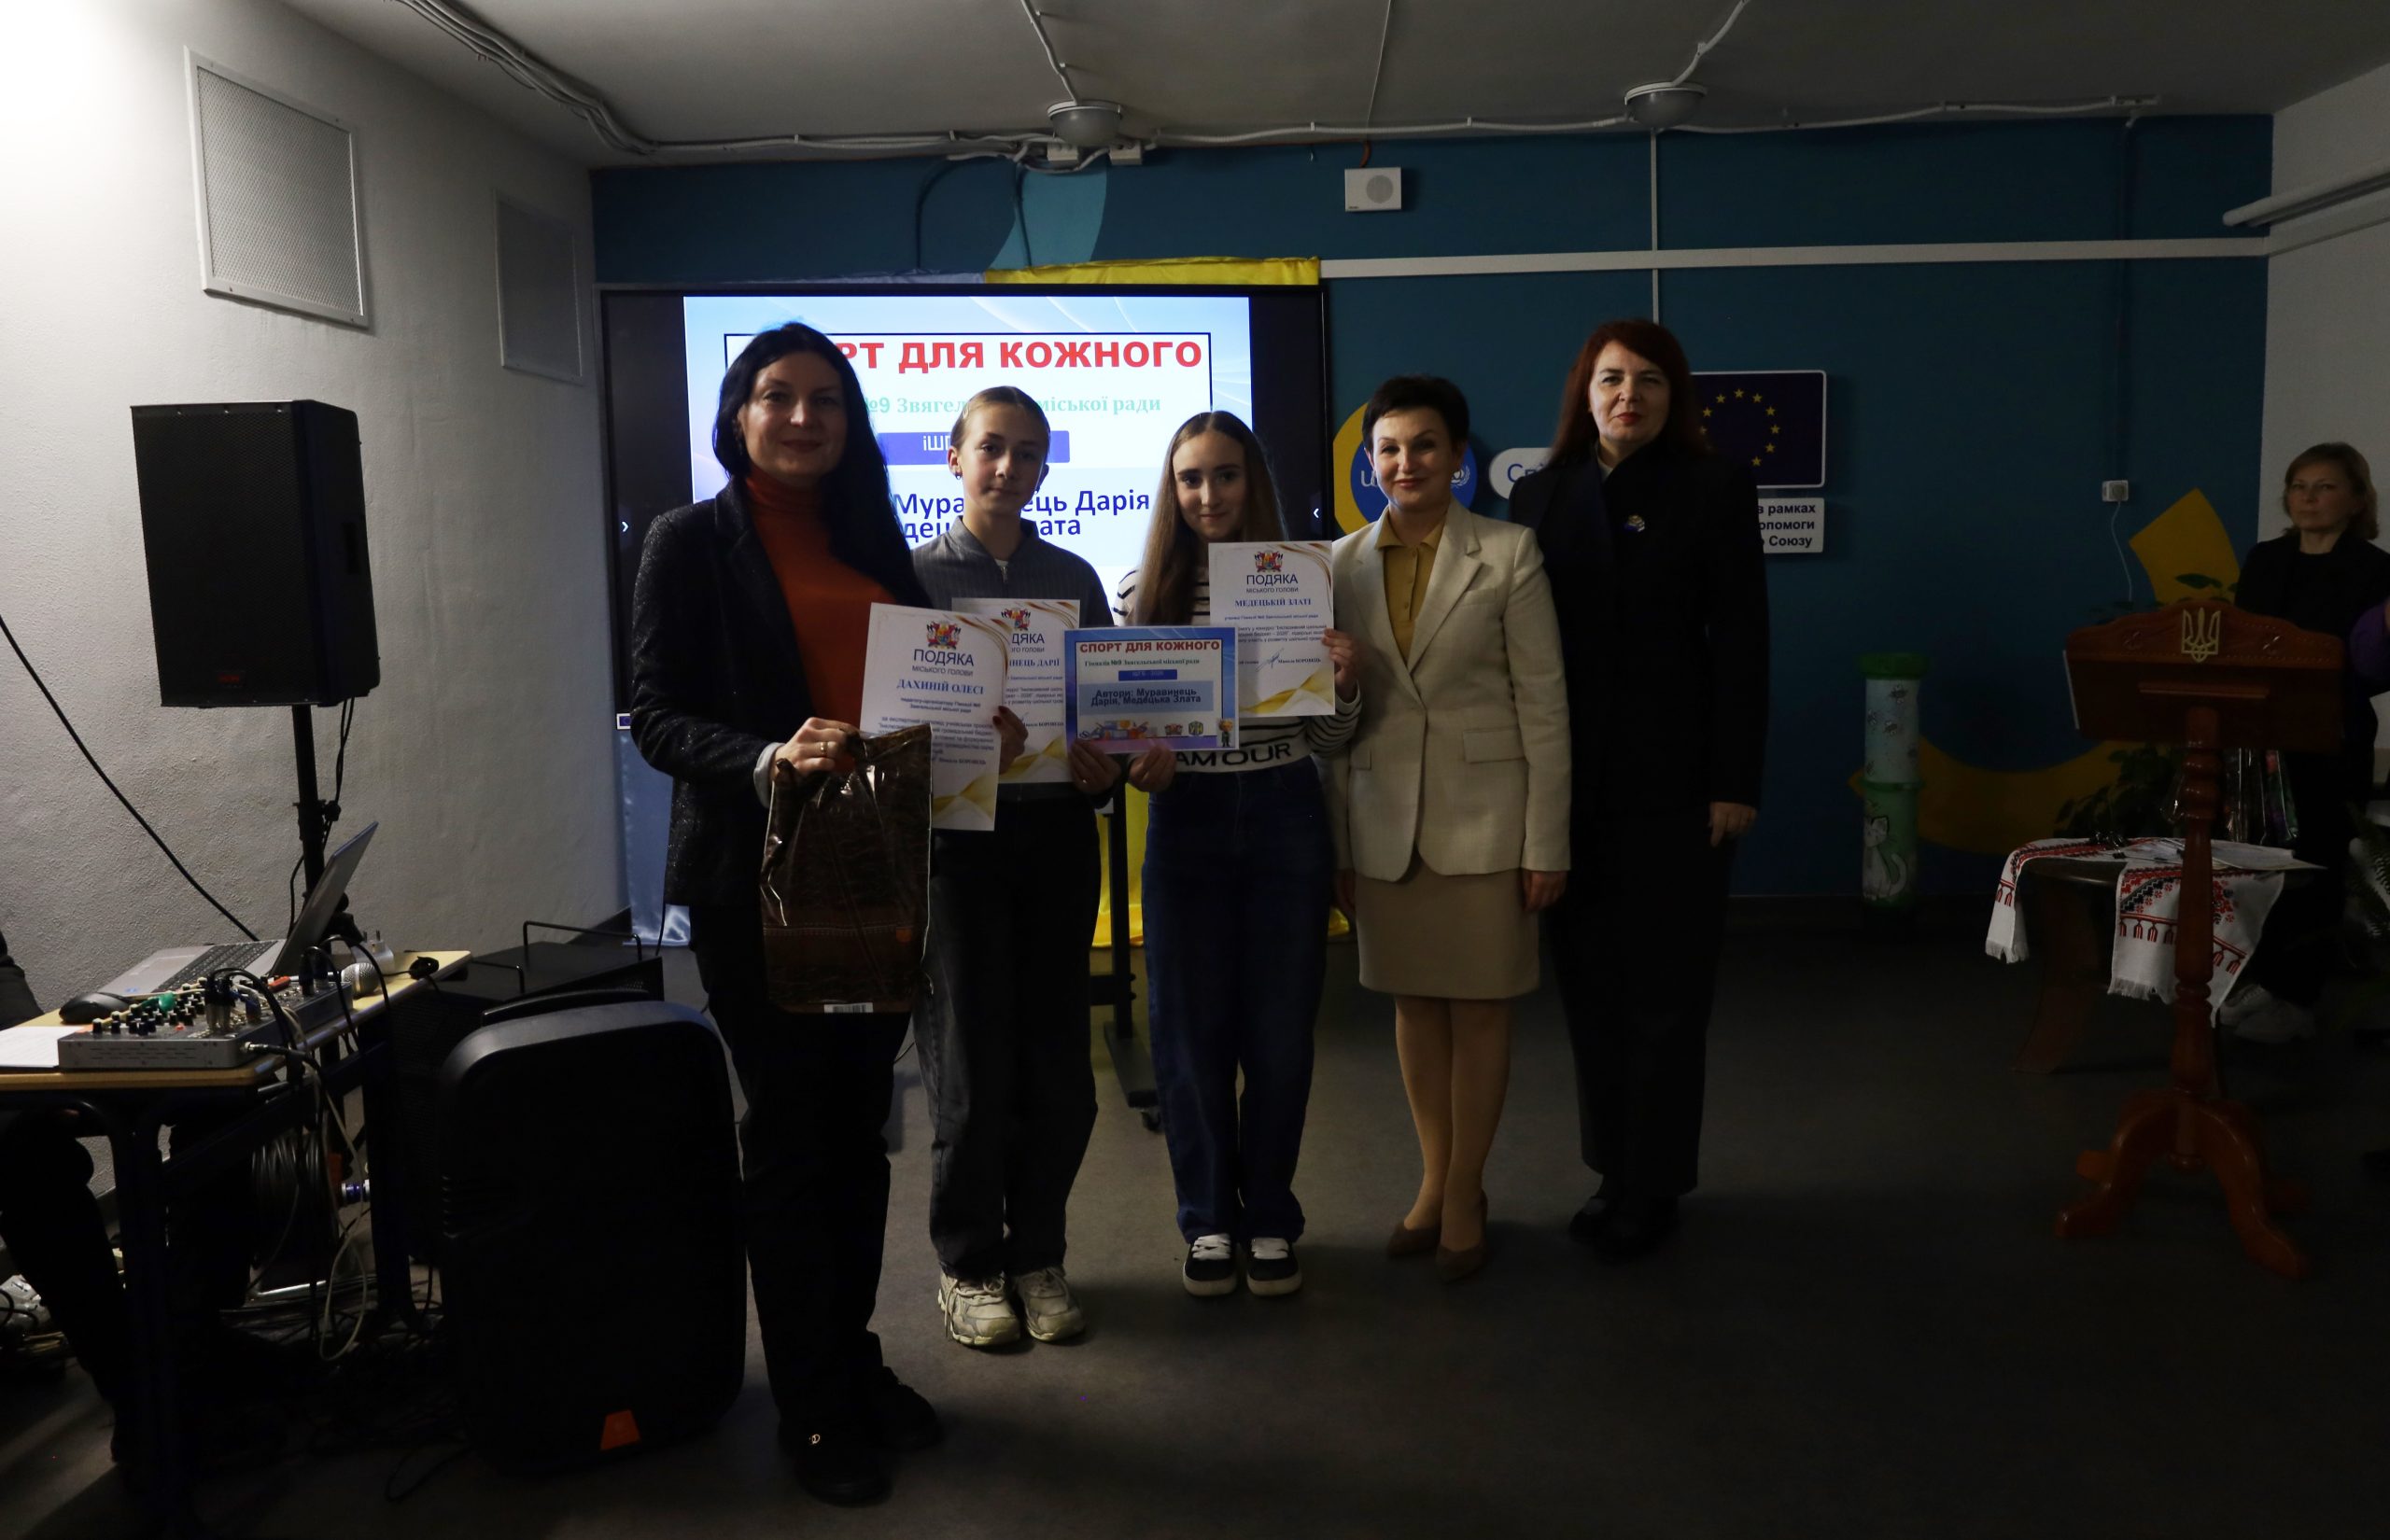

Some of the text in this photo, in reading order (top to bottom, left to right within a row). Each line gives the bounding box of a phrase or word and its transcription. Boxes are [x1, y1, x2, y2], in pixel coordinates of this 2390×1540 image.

[898, 342, 984, 374] ДЛЯ
[1000, 341, 1202, 369] КОЖНОГО
[1112, 398, 1161, 415] ради
[1075, 488, 1150, 516] Дарія
[1767, 504, 1817, 516] рамках
[1759, 521, 1816, 530] опомоги
[1768, 535, 1813, 549] Союзу
[1246, 573, 1299, 586] ПОДЯКА
[1011, 633, 1045, 644] ДЯКА
[1079, 640, 1220, 653] СПОРТ ДЛЯ КОЖНОГО
[913, 649, 975, 666] ПОДЯКА
